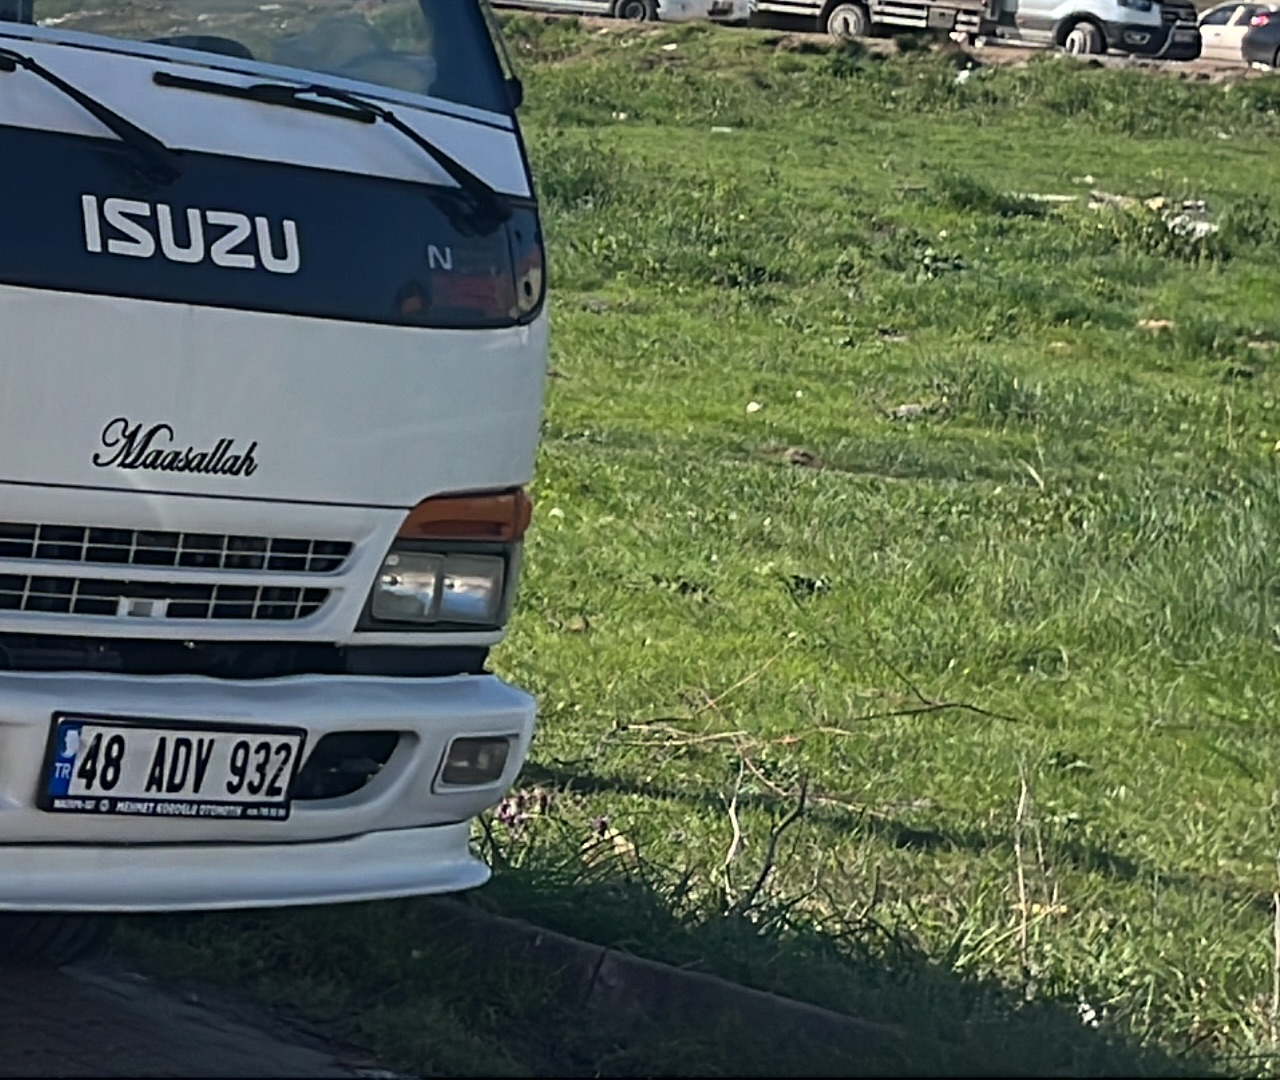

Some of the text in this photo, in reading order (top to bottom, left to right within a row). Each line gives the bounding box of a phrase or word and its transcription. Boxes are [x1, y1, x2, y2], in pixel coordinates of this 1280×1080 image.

[81, 194, 301, 275] ISUZU
[427, 244, 453, 270] N
[92, 417, 258, 477] Maasallah
[54, 762, 71, 779] TR
[76, 732, 292, 797] 48 ADV 932
